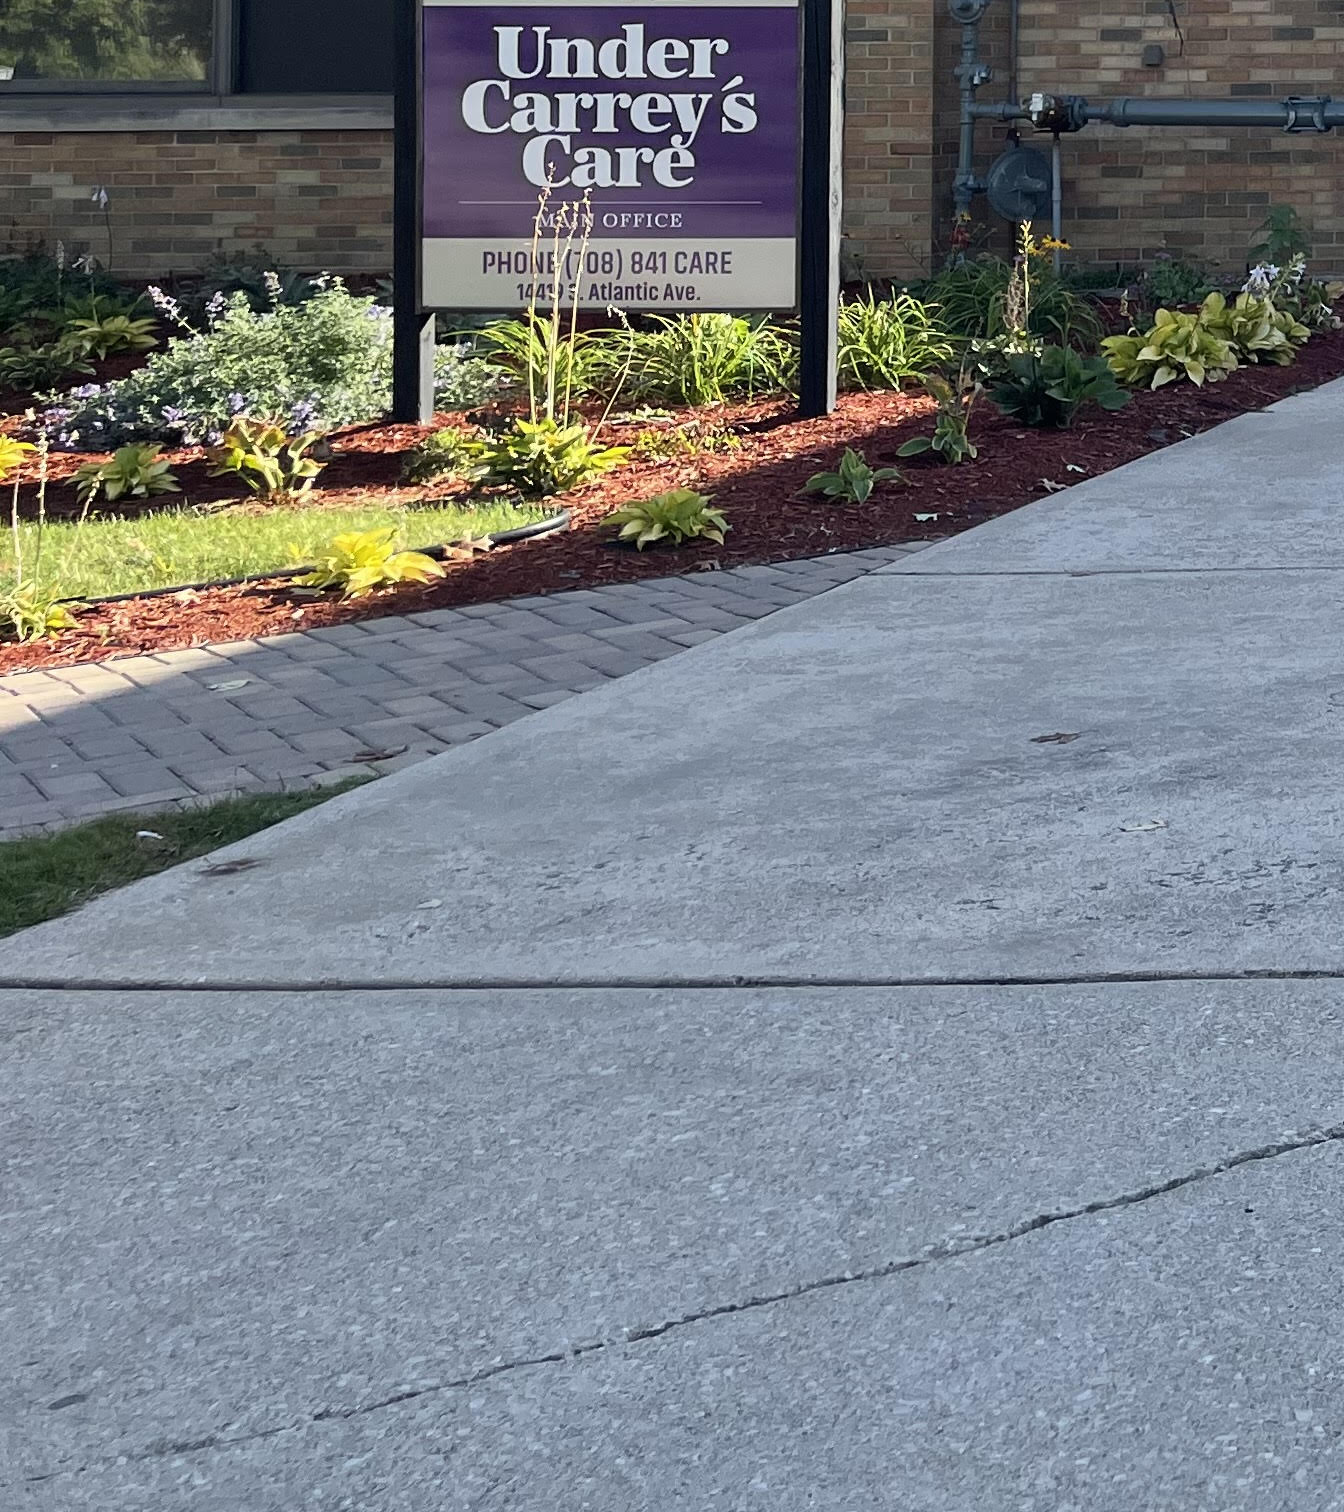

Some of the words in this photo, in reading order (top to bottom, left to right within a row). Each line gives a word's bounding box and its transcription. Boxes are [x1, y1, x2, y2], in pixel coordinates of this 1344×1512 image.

[494, 24, 730, 80] Under
[461, 76, 758, 149] Carrey's
[522, 135, 695, 189] Care
[539, 213, 595, 228] MAN
[602, 213, 683, 228] OFFICE
[482, 251, 556, 275] PHONE
[630, 251, 667, 275] 841
[674, 251, 733, 275] CARE
[588, 281, 659, 301] Atlantic
[663, 283, 701, 301] Ave.
